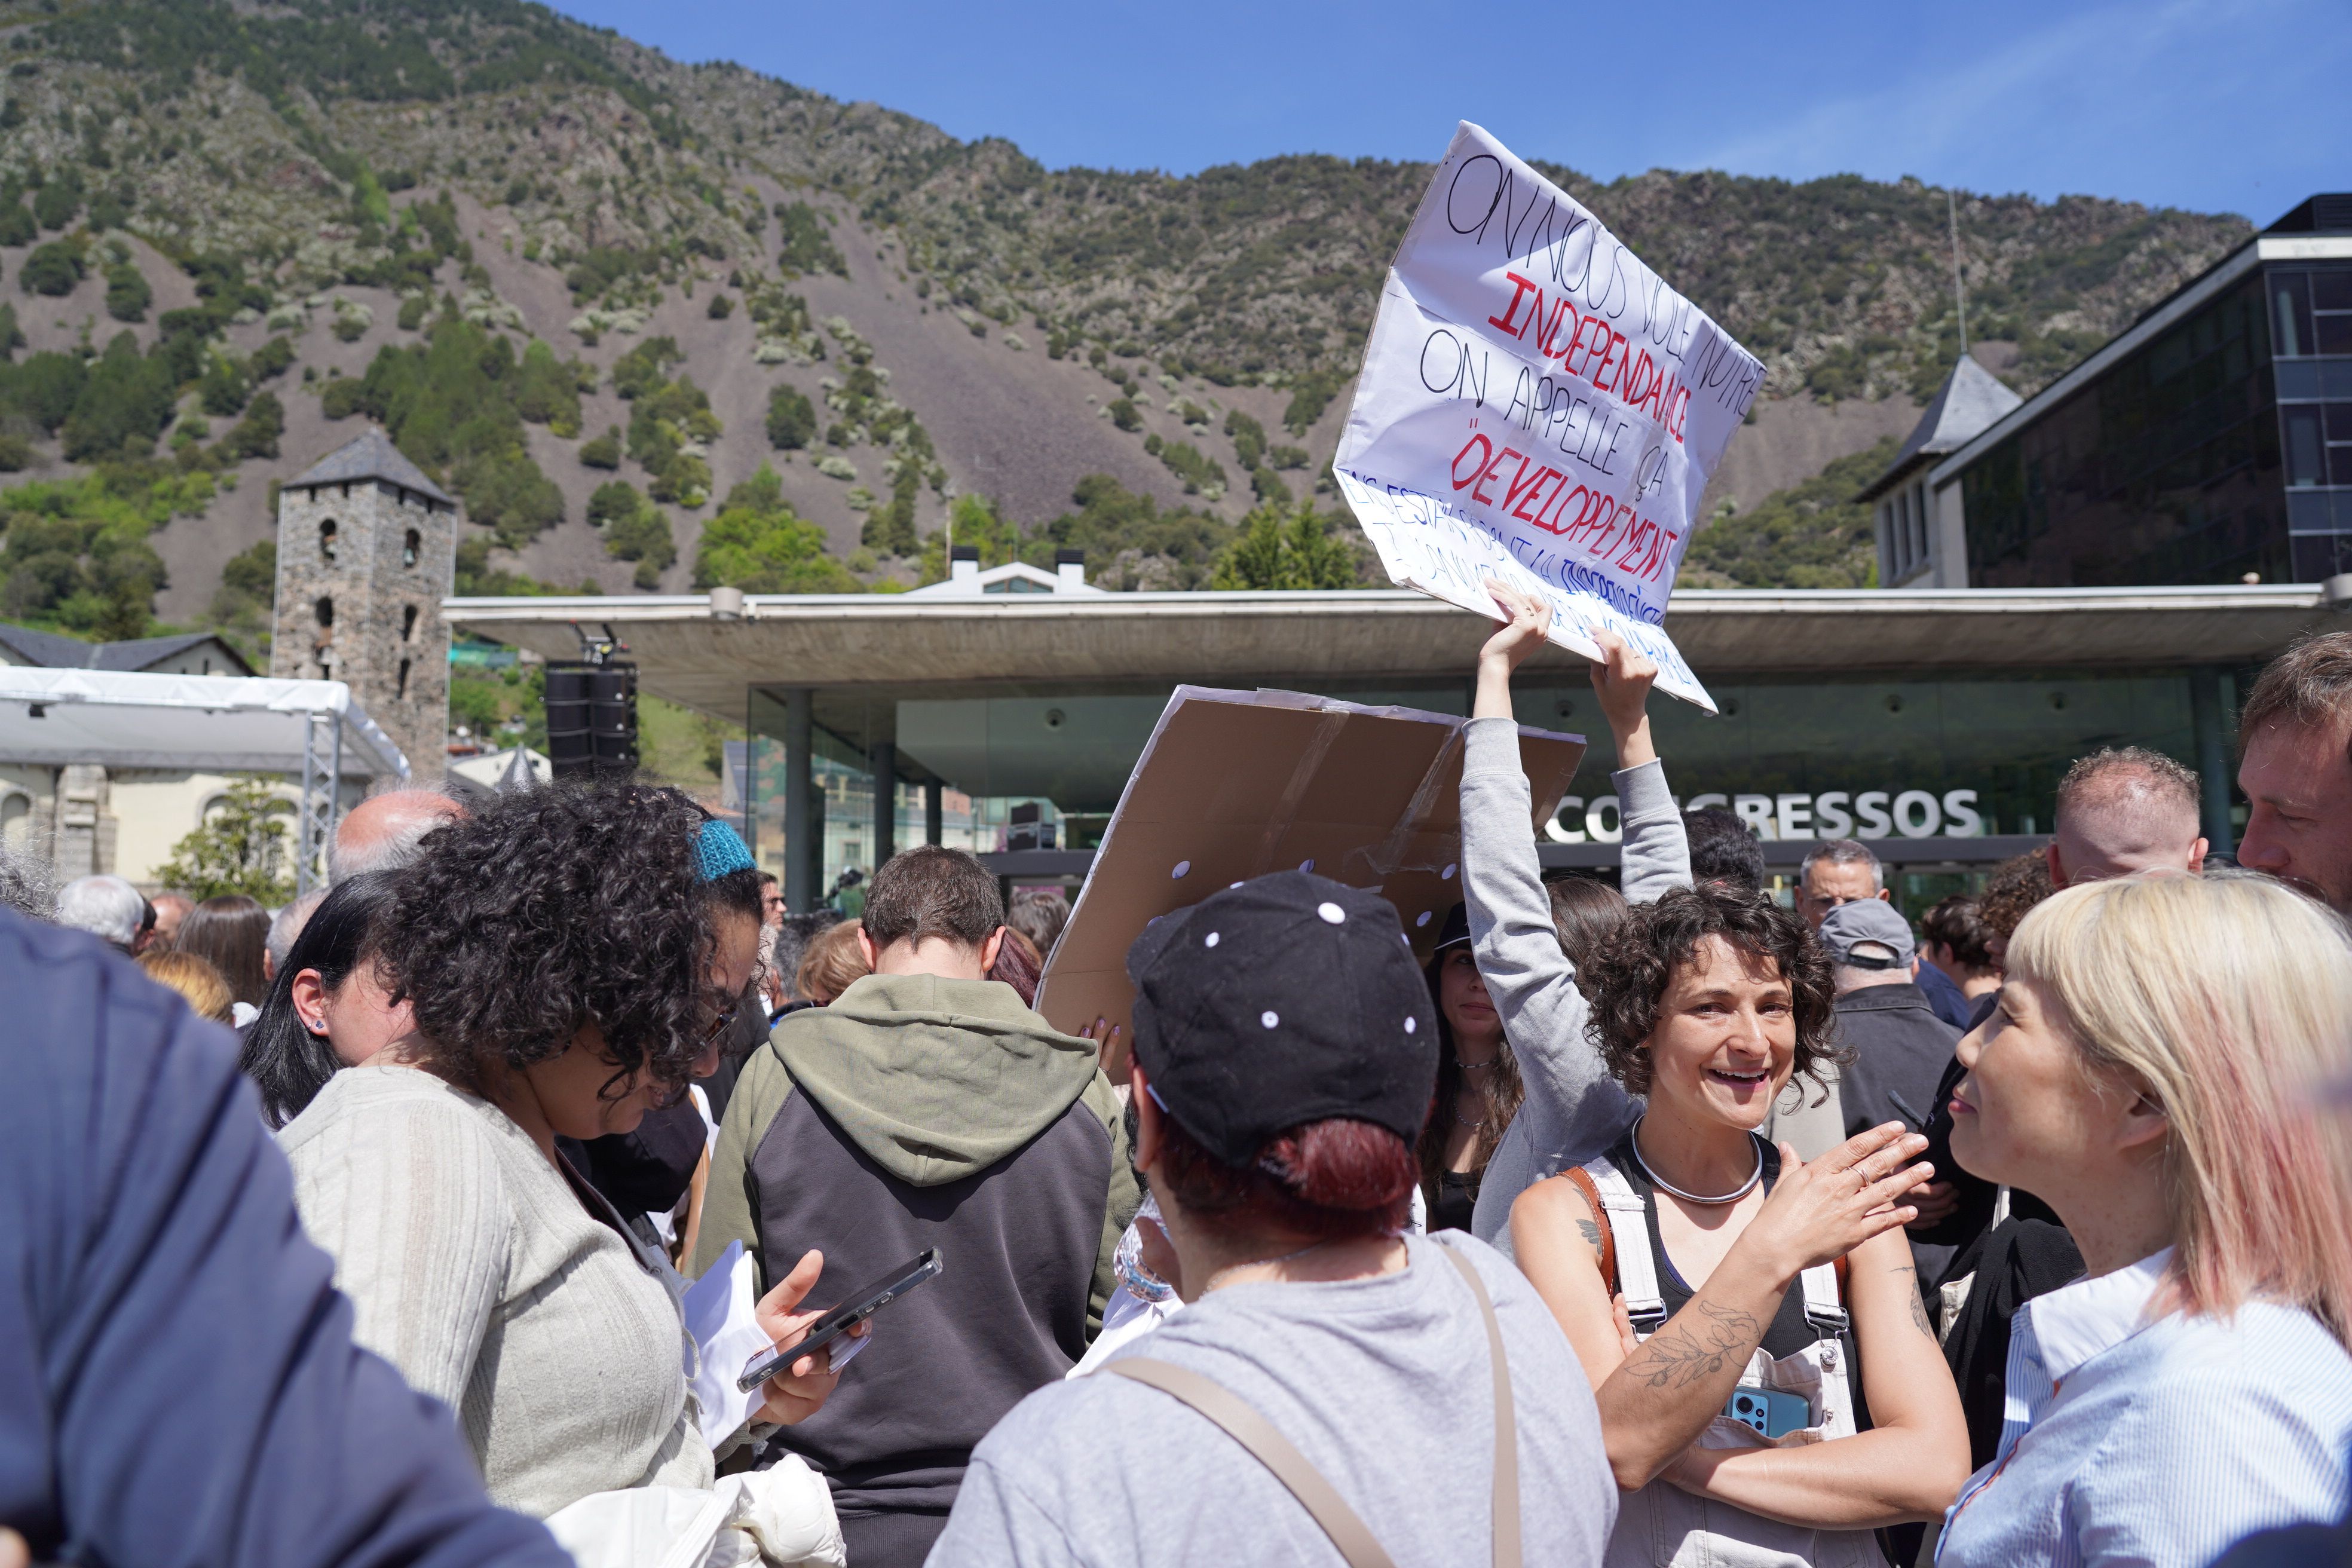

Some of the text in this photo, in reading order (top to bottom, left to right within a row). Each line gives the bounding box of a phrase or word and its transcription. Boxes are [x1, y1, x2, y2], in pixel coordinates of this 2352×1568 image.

[1447, 154, 1768, 418] ON NOUS VOLE NOTRE
[1488, 271, 1690, 443] INDEPENDANCE
[1420, 329, 1669, 502] ON APPELLE ÇA
[1544, 789, 1979, 844] CORESSOS
